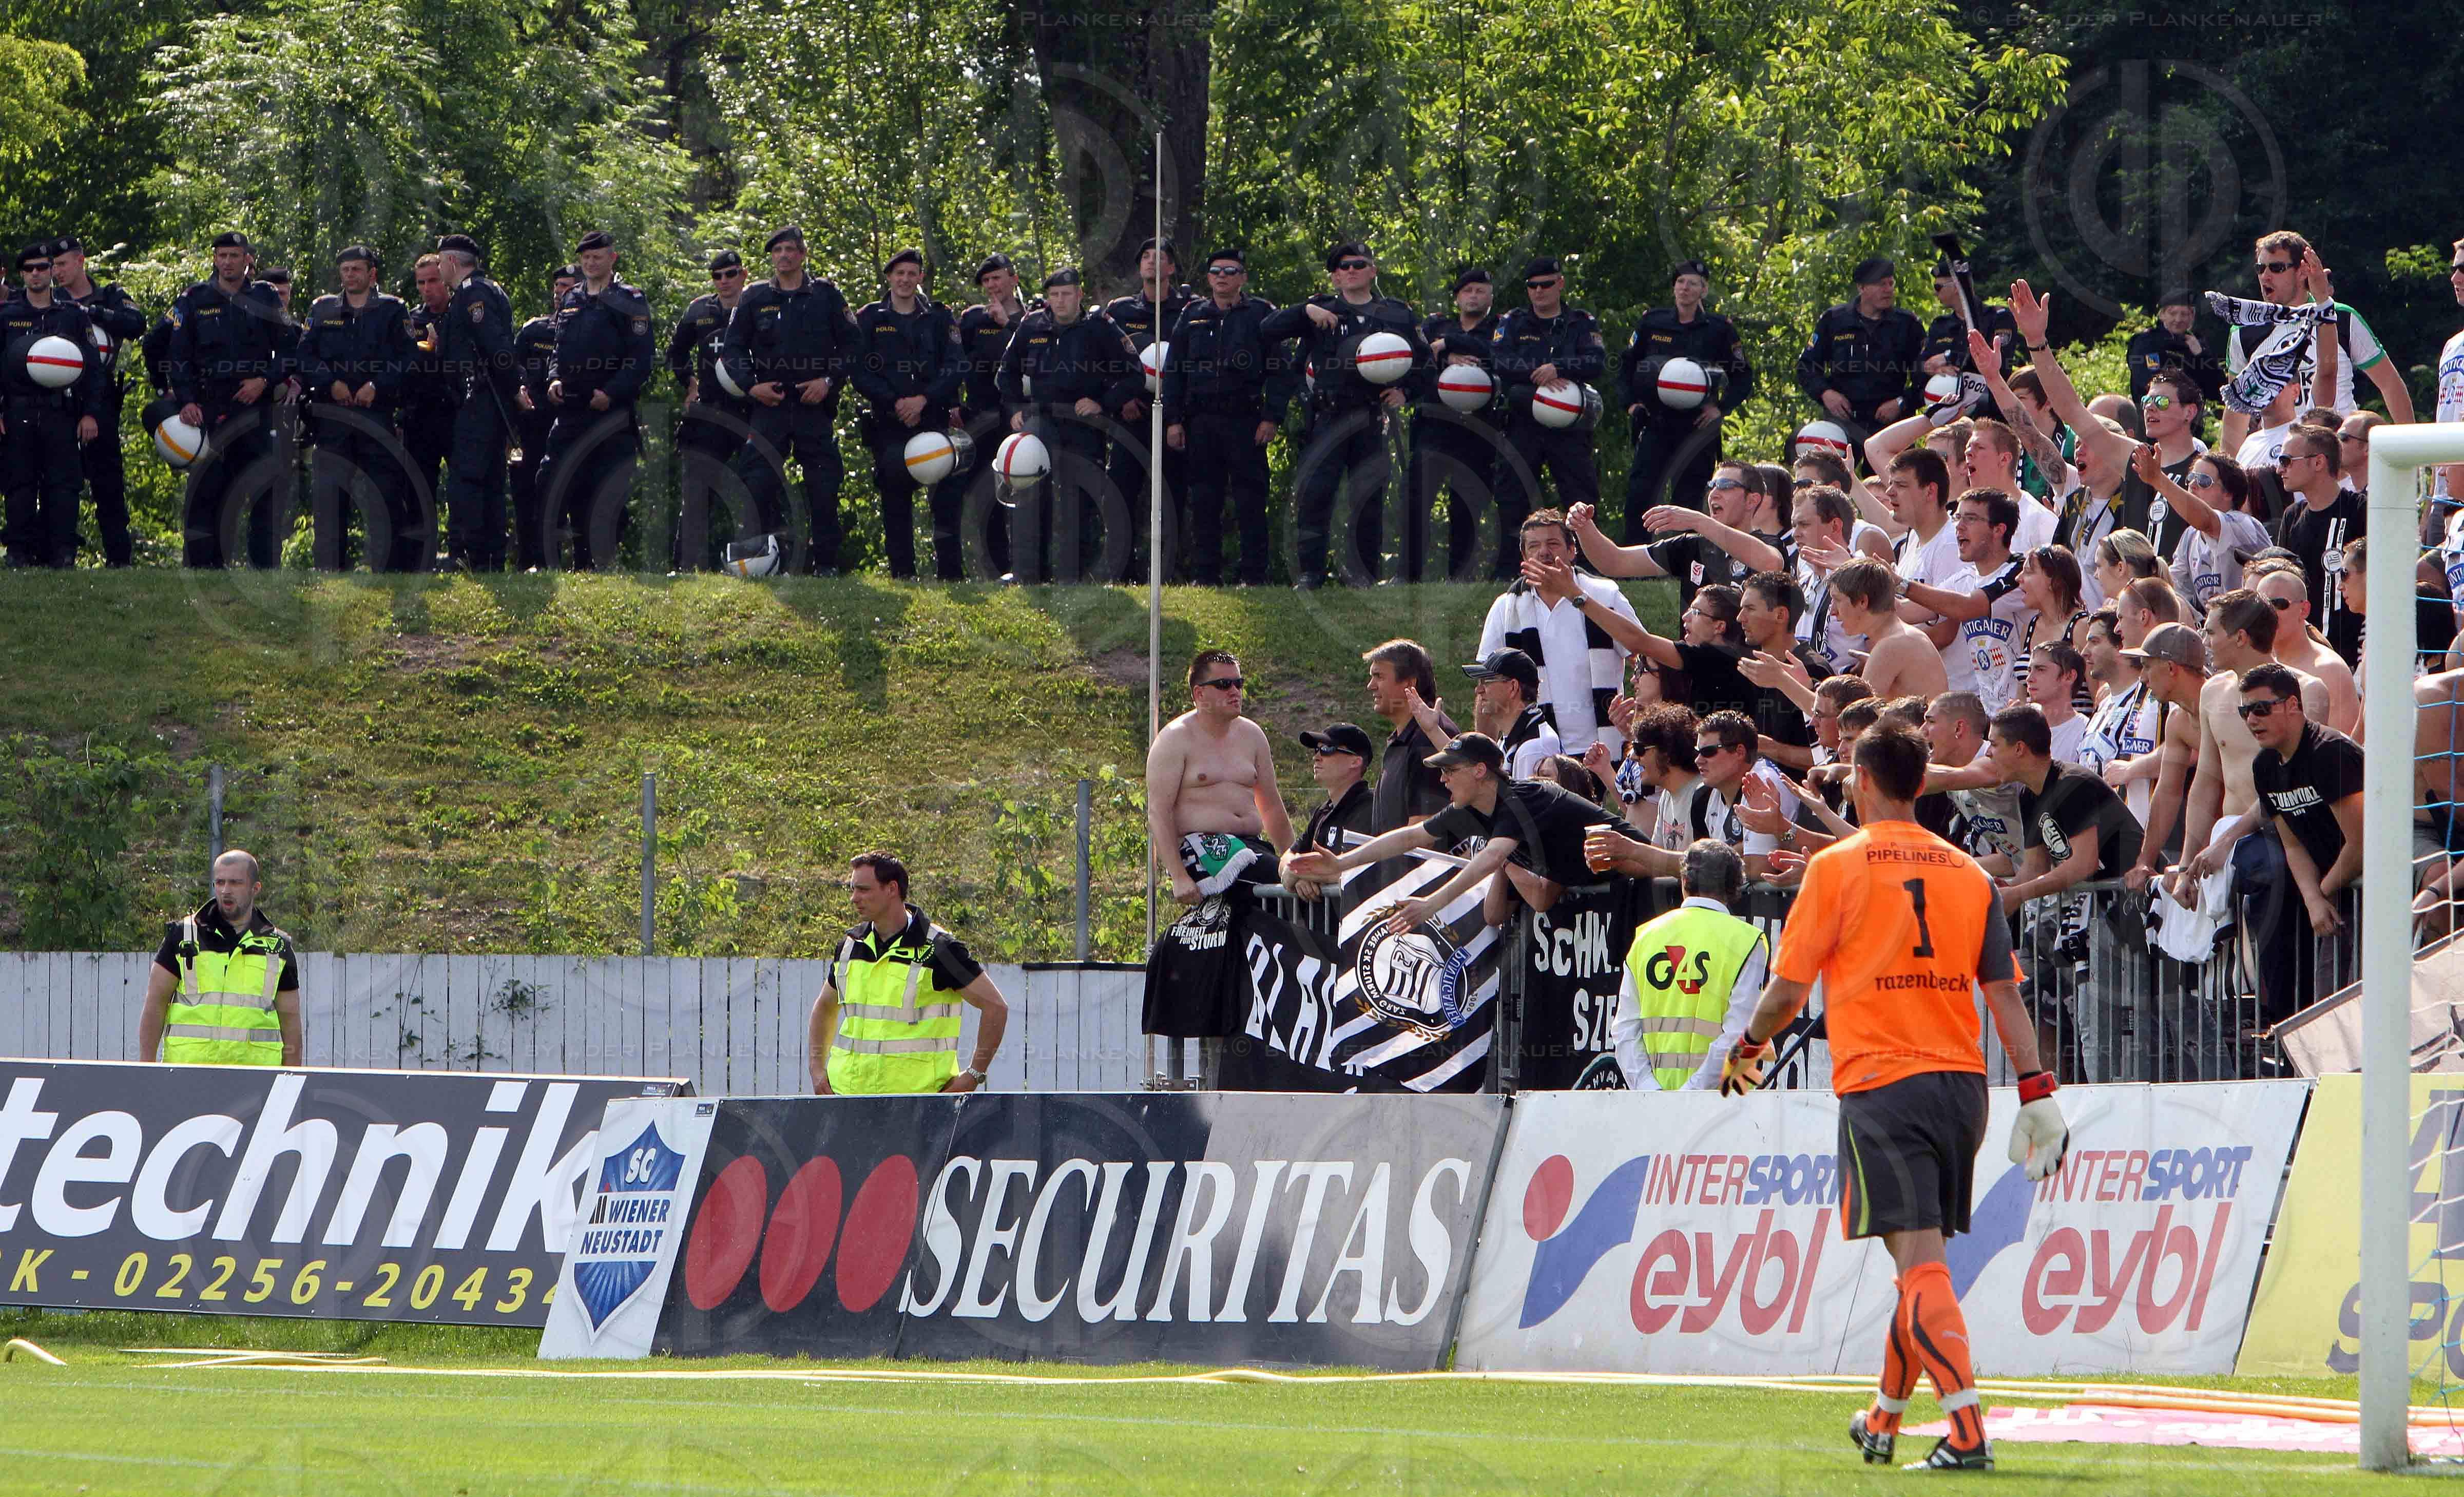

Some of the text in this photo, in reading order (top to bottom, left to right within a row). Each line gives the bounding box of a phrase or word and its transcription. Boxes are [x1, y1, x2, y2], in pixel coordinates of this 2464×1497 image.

[1651, 335, 1672, 343] POLIZEI
[1866, 850, 1947, 863] PIPELINES
[1903, 878, 1935, 958] 1
[1646, 945, 1710, 994] G4S
[1875, 970, 1969, 992] razenbeck
[1573, 988, 1618, 1052] SZE
[0, 1073, 600, 1253] technik
[625, 1147, 657, 1184] SC
[608, 1198, 670, 1224] WIENER
[579, 1229, 664, 1256] NEUSTADT
[899, 1155, 1473, 1327] SECURITAS
[1630, 1208, 1833, 1335] eybl
[2022, 1203, 2232, 1336] eybl
